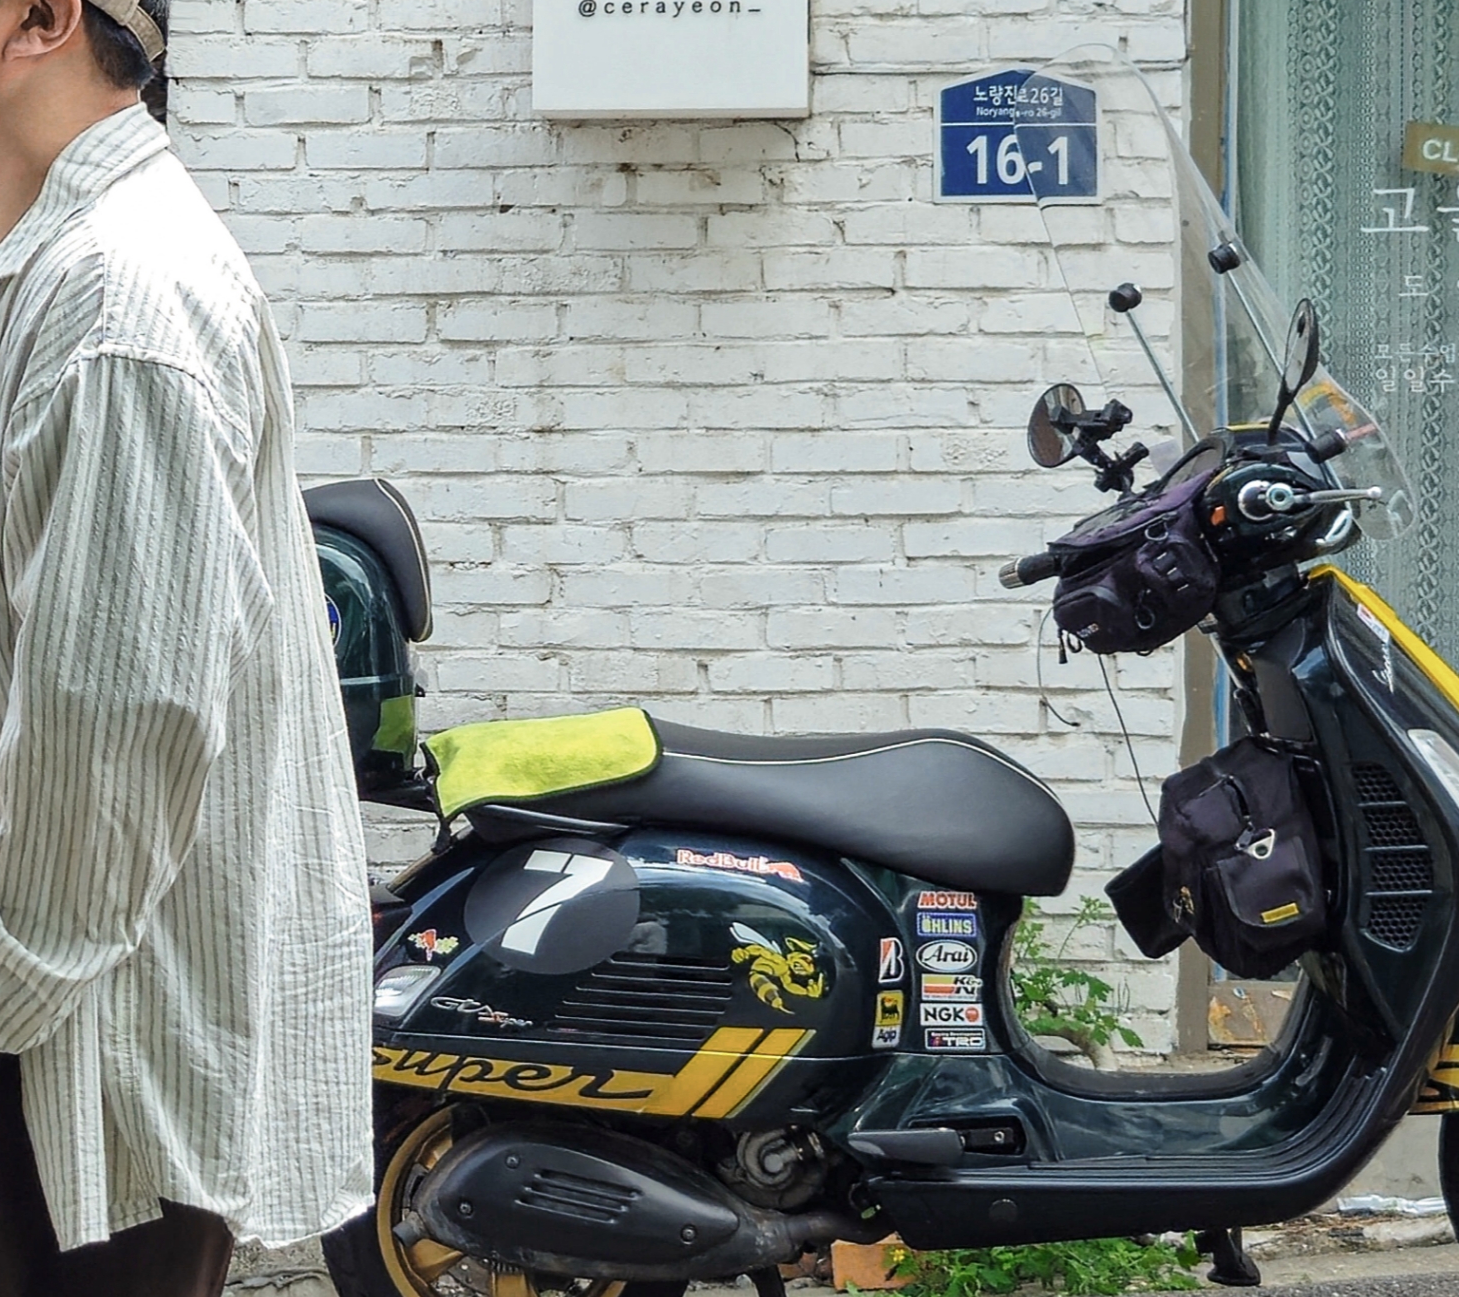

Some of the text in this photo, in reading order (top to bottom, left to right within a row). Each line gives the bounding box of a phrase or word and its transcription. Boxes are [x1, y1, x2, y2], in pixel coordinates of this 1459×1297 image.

[966, 134, 1069, 185] 16-1
[501, 850, 614, 955] 7
[918, 891, 977, 909] MOTUL
[924, 945, 969, 962] Arai
[924, 1006, 965, 1022] NGK
